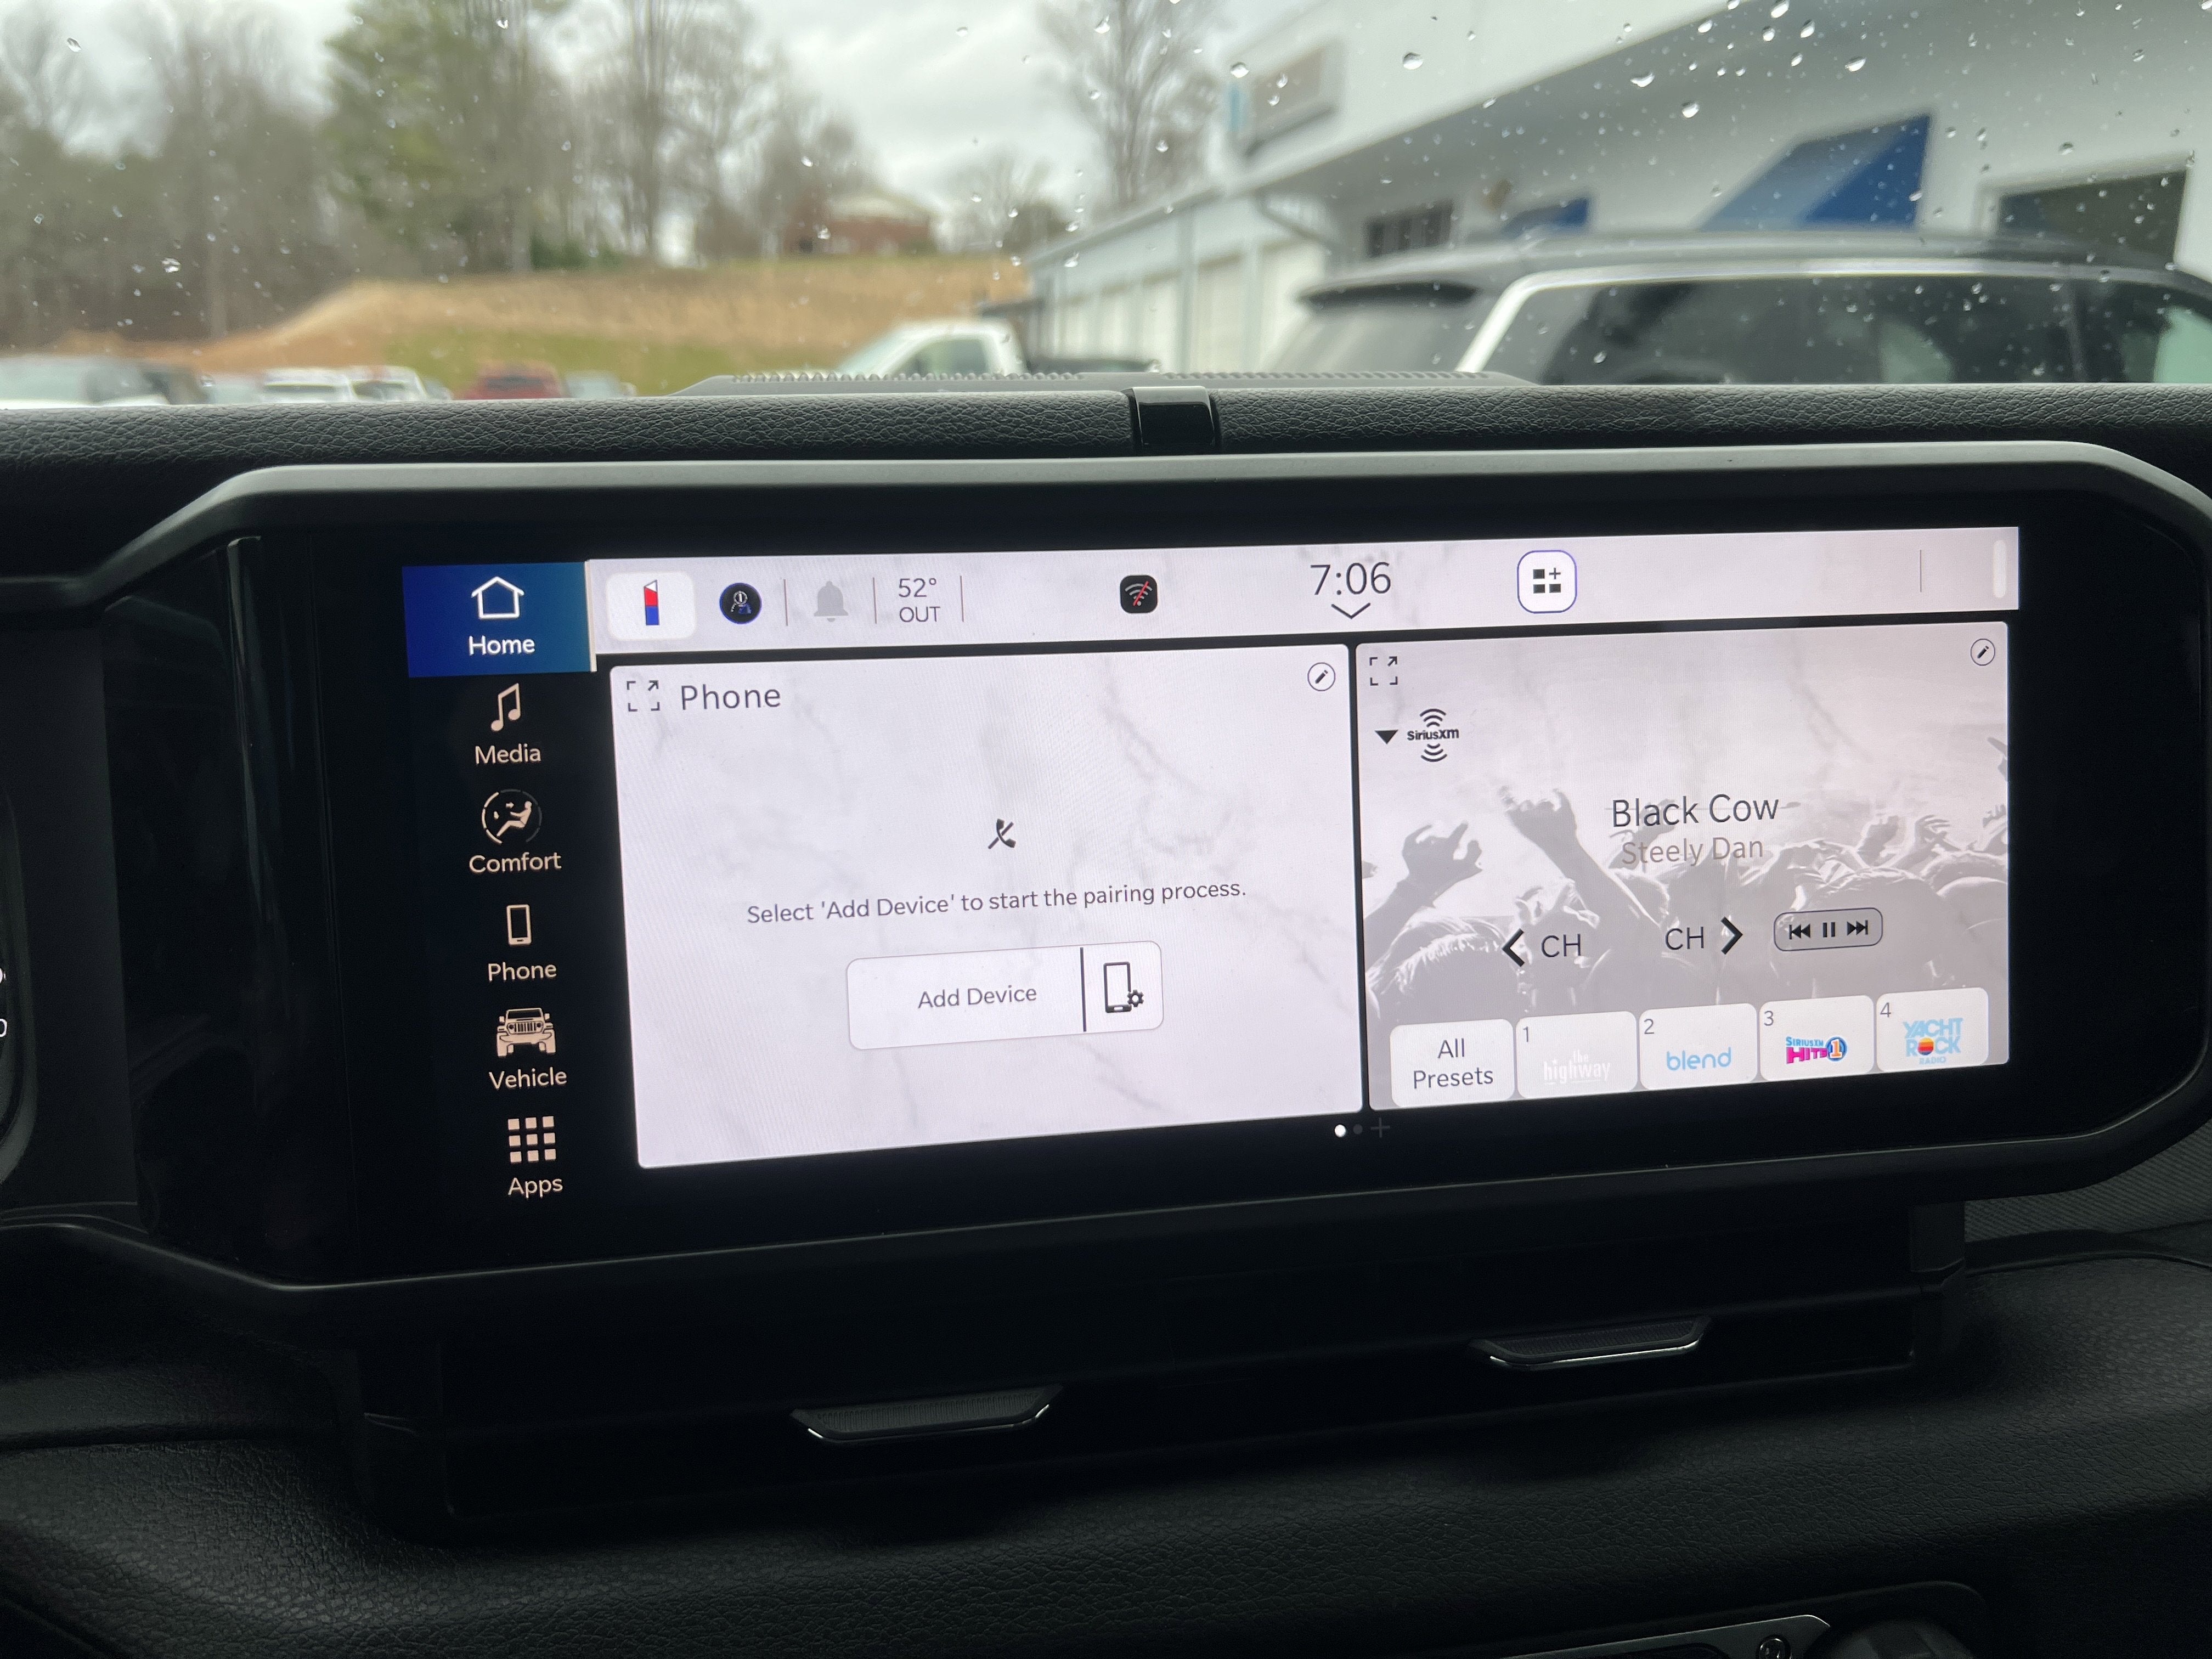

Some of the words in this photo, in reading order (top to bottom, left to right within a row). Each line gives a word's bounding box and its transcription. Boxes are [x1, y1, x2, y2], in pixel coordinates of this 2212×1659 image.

[899, 578, 936, 597] 52°
[1310, 562, 1391, 595] 7:06
[899, 606, 941, 623] OUT
[469, 636, 535, 656] Home
[681, 685, 781, 710] Phone
[475, 743, 541, 764] Media
[1613, 795, 1699, 827] Black
[1709, 793, 1779, 822] Cow
[469, 852, 562, 873] Comfort
[1622, 838, 1703, 866] Steely
[1712, 837, 1763, 860] Dan
[747, 904, 814, 923] Select
[821, 899, 870, 919] 'Add
[877, 894, 955, 916] Device'
[961, 895, 983, 911] to
[989, 891, 1038, 909] start
[1043, 888, 1077, 906] the
[1084, 884, 1154, 908] pairing
[1162, 883, 1246, 904] process.
[1541, 933, 1581, 957] CH
[1665, 926, 1704, 950] CH
[488, 961, 557, 981] Phone
[918, 988, 960, 1008] Add
[967, 985, 1037, 1005] Device
[1764, 1011, 1775, 1026] 3
[1880, 1002, 1892, 1018] 4
[1643, 1018, 1655, 1035] 2
[1903, 1017, 1963, 1039] YACHT
[1437, 1038, 1465, 1059] All
[1666, 1047, 1731, 1071] blend
[1543, 1058, 1611, 1084] highway
[1919, 1056, 1946, 1065] RADIO
[489, 1067, 567, 1090] Vehicle
[1413, 1067, 1493, 1089] Presets
[508, 1176, 563, 1198] Apps
